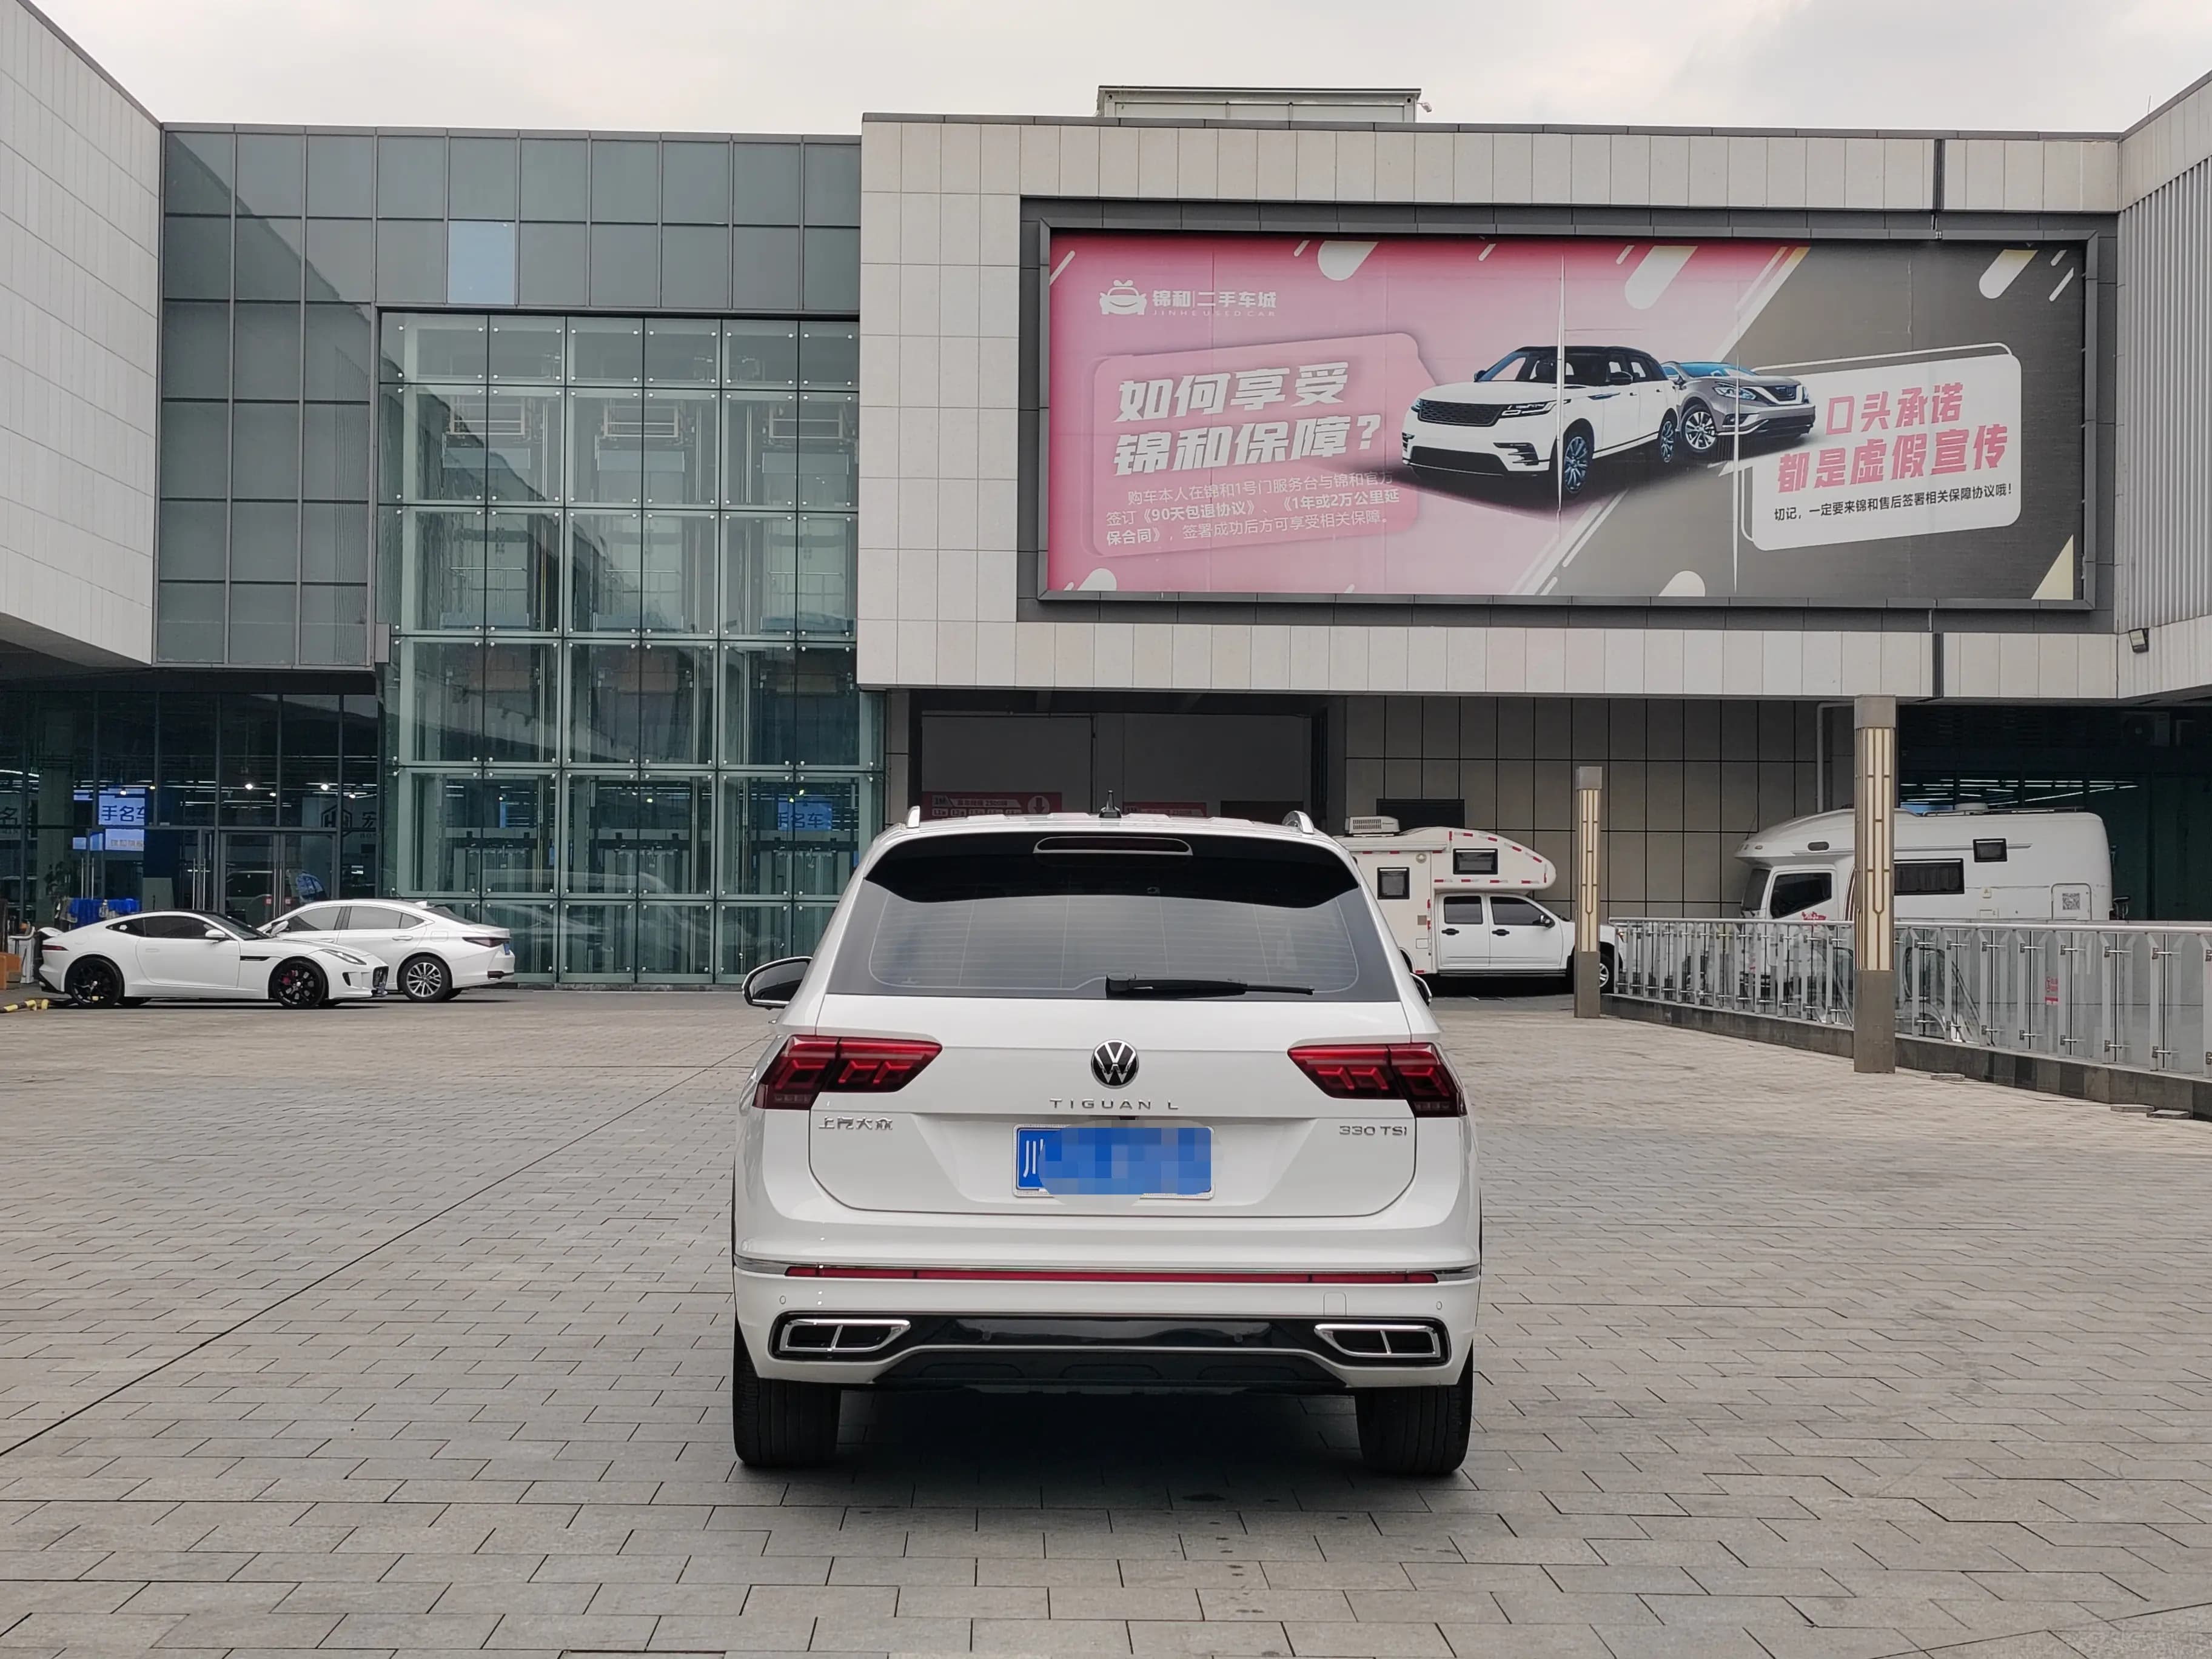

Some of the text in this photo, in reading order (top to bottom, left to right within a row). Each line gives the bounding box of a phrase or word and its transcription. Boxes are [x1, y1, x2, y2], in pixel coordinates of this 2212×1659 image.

[1111, 361, 1349, 423] 如何享受
[1825, 382, 1964, 436] 口头承诺
[1113, 414, 1381, 476] 锦和保障?
[1777, 423, 2008, 493] 都是虚假宣传
[1127, 471, 1393, 506] 购车本人在锦和1号门服务台与锦和官方
[1049, 1098, 1179, 1110] TIGUAN L
[1339, 1125, 1375, 1136] 330
